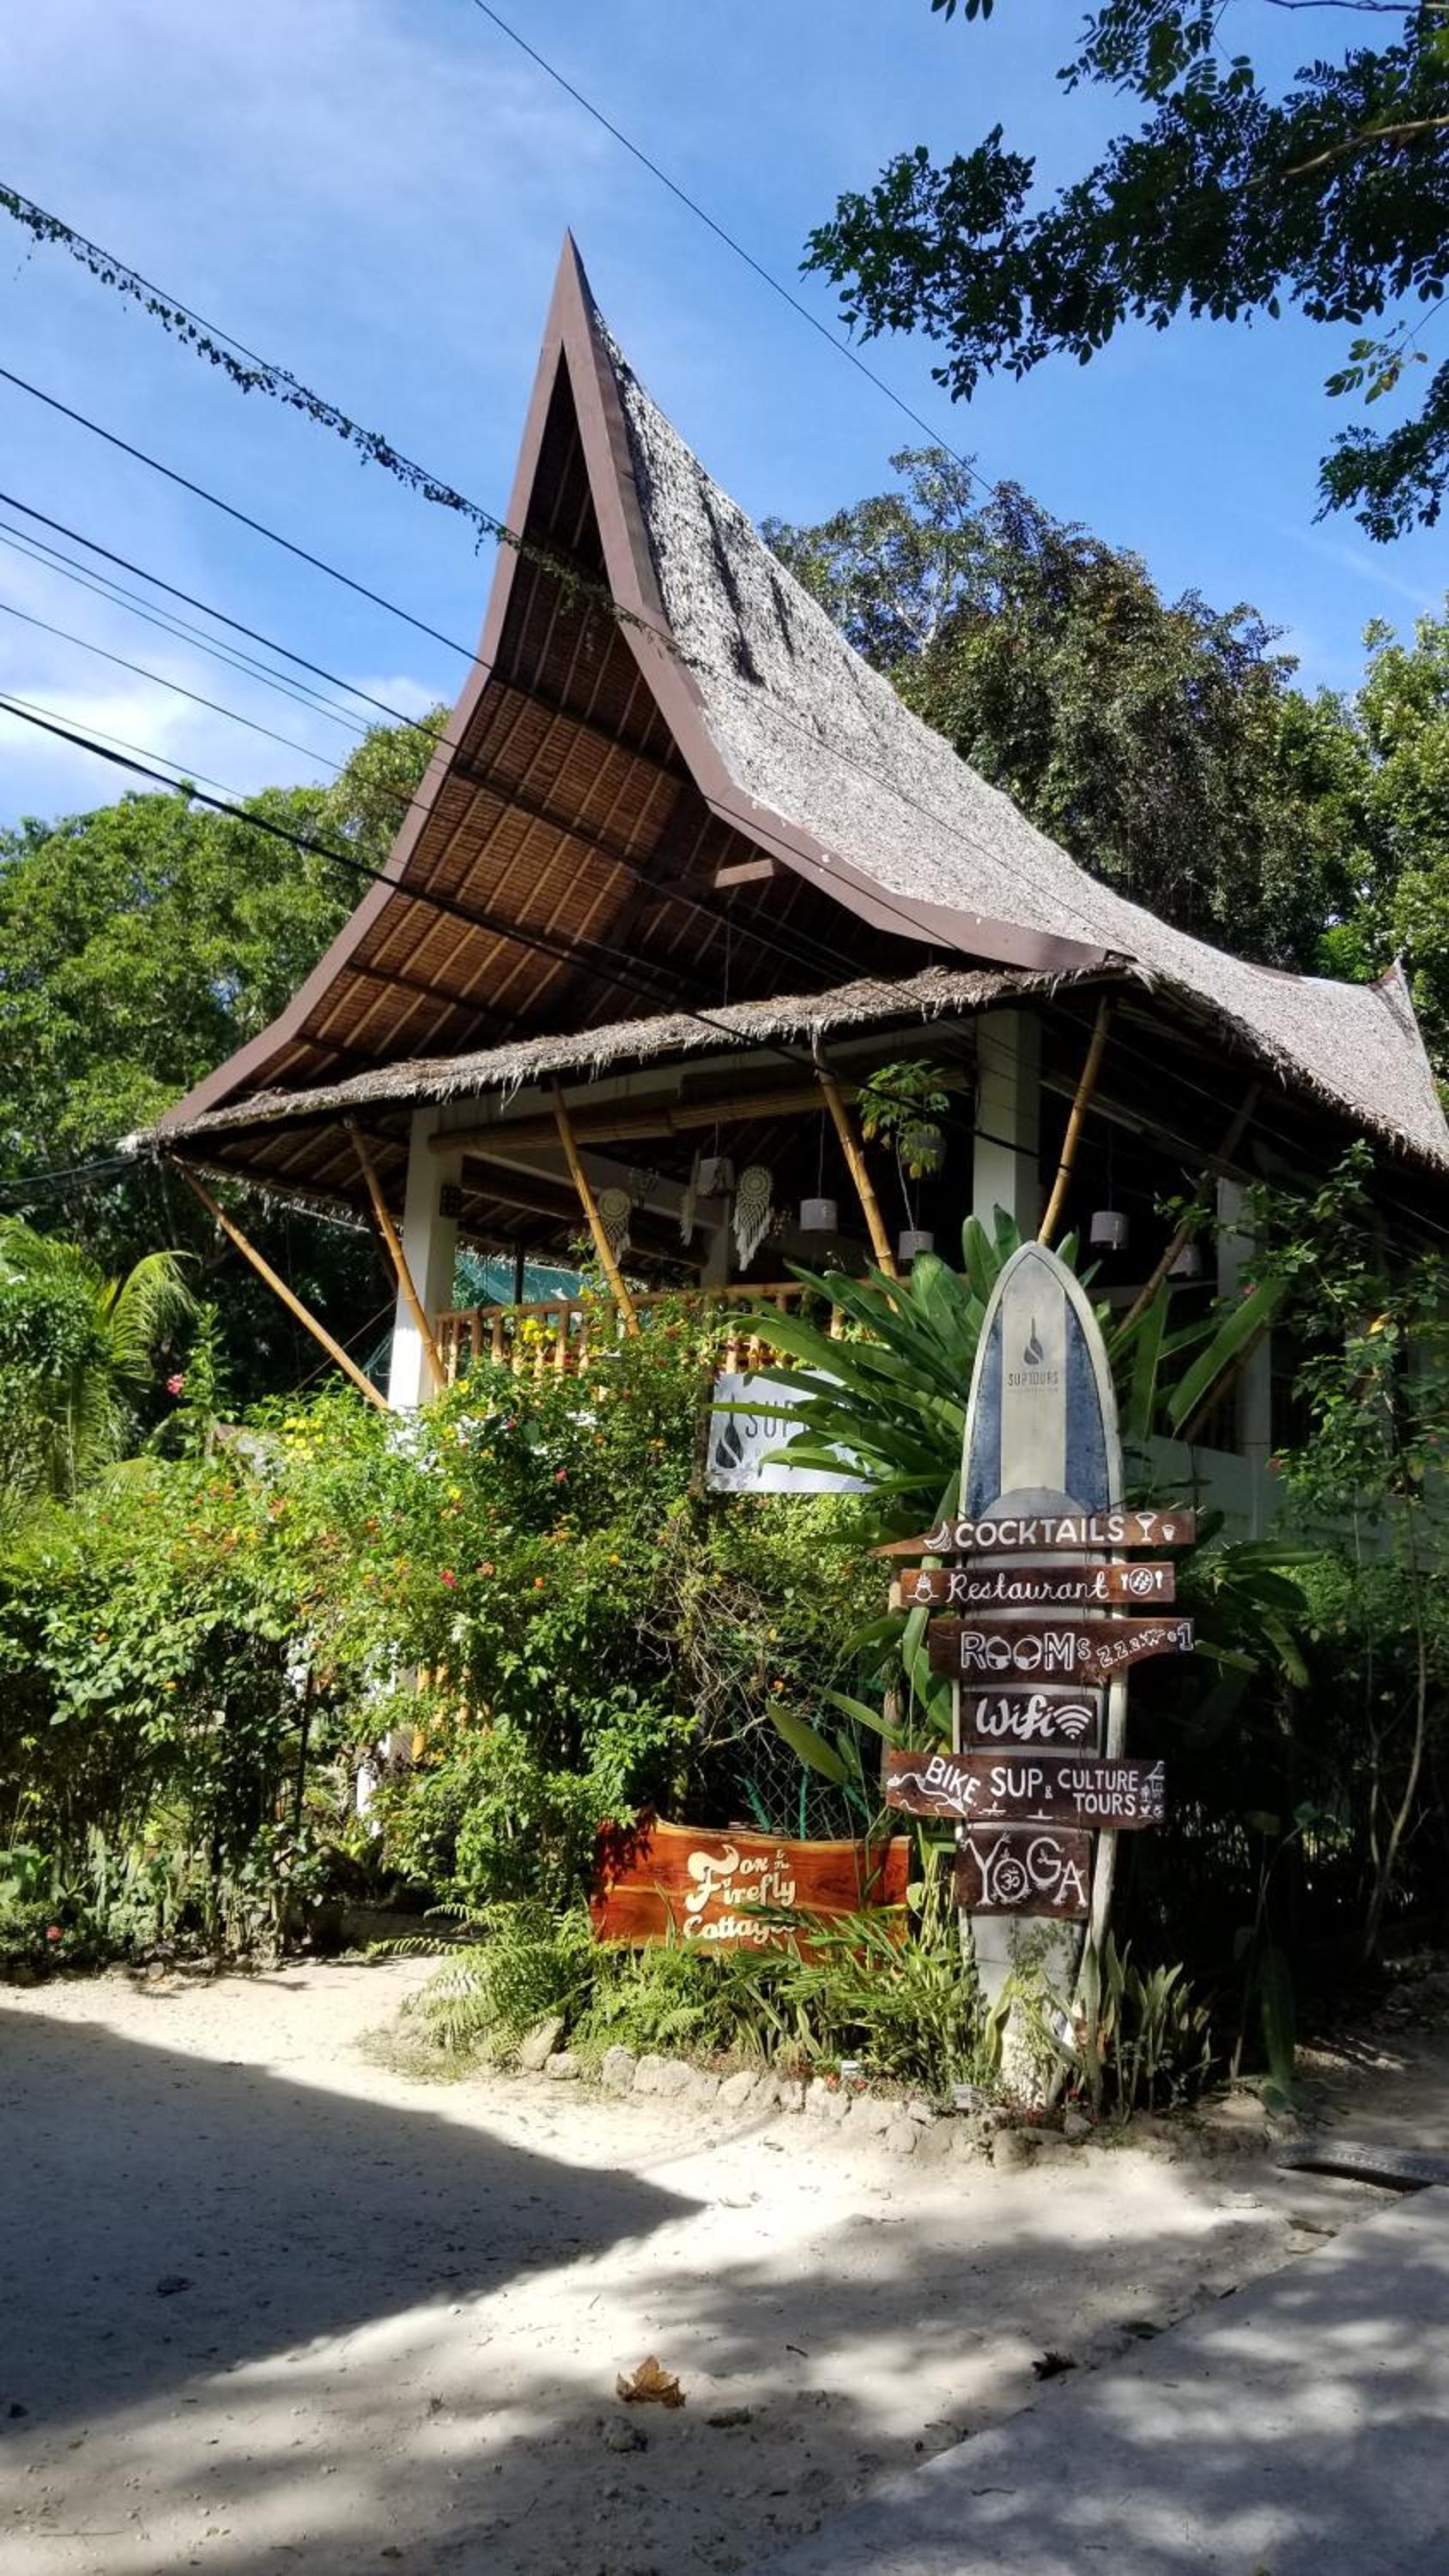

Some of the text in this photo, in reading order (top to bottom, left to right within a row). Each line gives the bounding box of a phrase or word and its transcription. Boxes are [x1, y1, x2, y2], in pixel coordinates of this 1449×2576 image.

[955, 1516, 1125, 1547] COCKTAILS
[946, 1571, 1109, 1603] Restaurant
[990, 1767, 1043, 1798] SUP
[1058, 1768, 1139, 1793] CULTURE
[1073, 1792, 1137, 1816] TOURS
[960, 1830, 1088, 1908] YOGA
